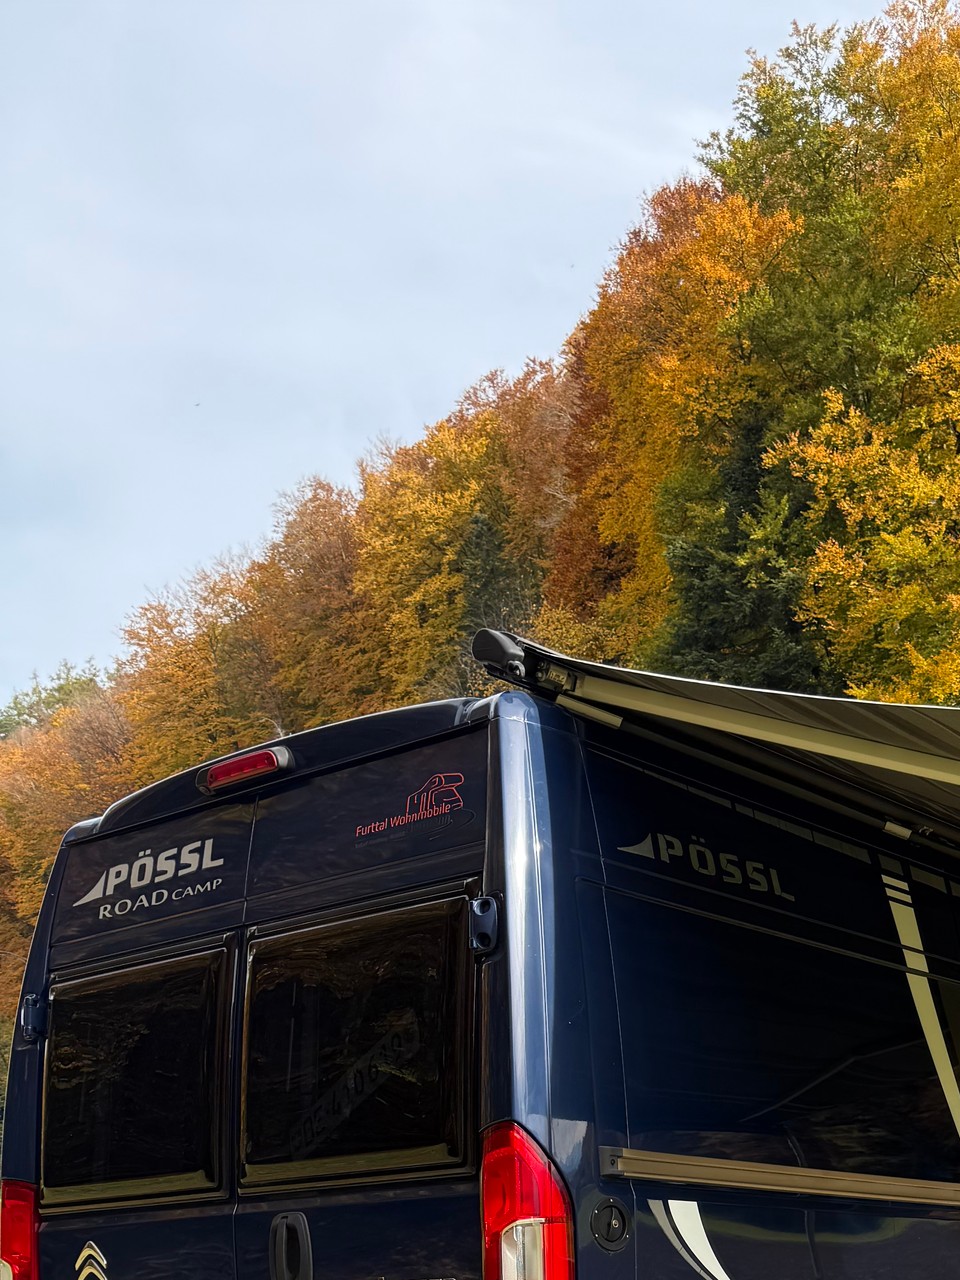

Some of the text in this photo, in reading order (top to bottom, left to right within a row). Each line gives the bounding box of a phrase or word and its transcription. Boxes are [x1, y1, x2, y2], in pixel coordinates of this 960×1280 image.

[355, 818, 388, 837] Furttal
[390, 802, 451, 828] Wohnmobile
[105, 838, 224, 896] PÖSSL
[656, 833, 796, 902] PÖSSL
[98, 878, 223, 920] ROAD CAMP
